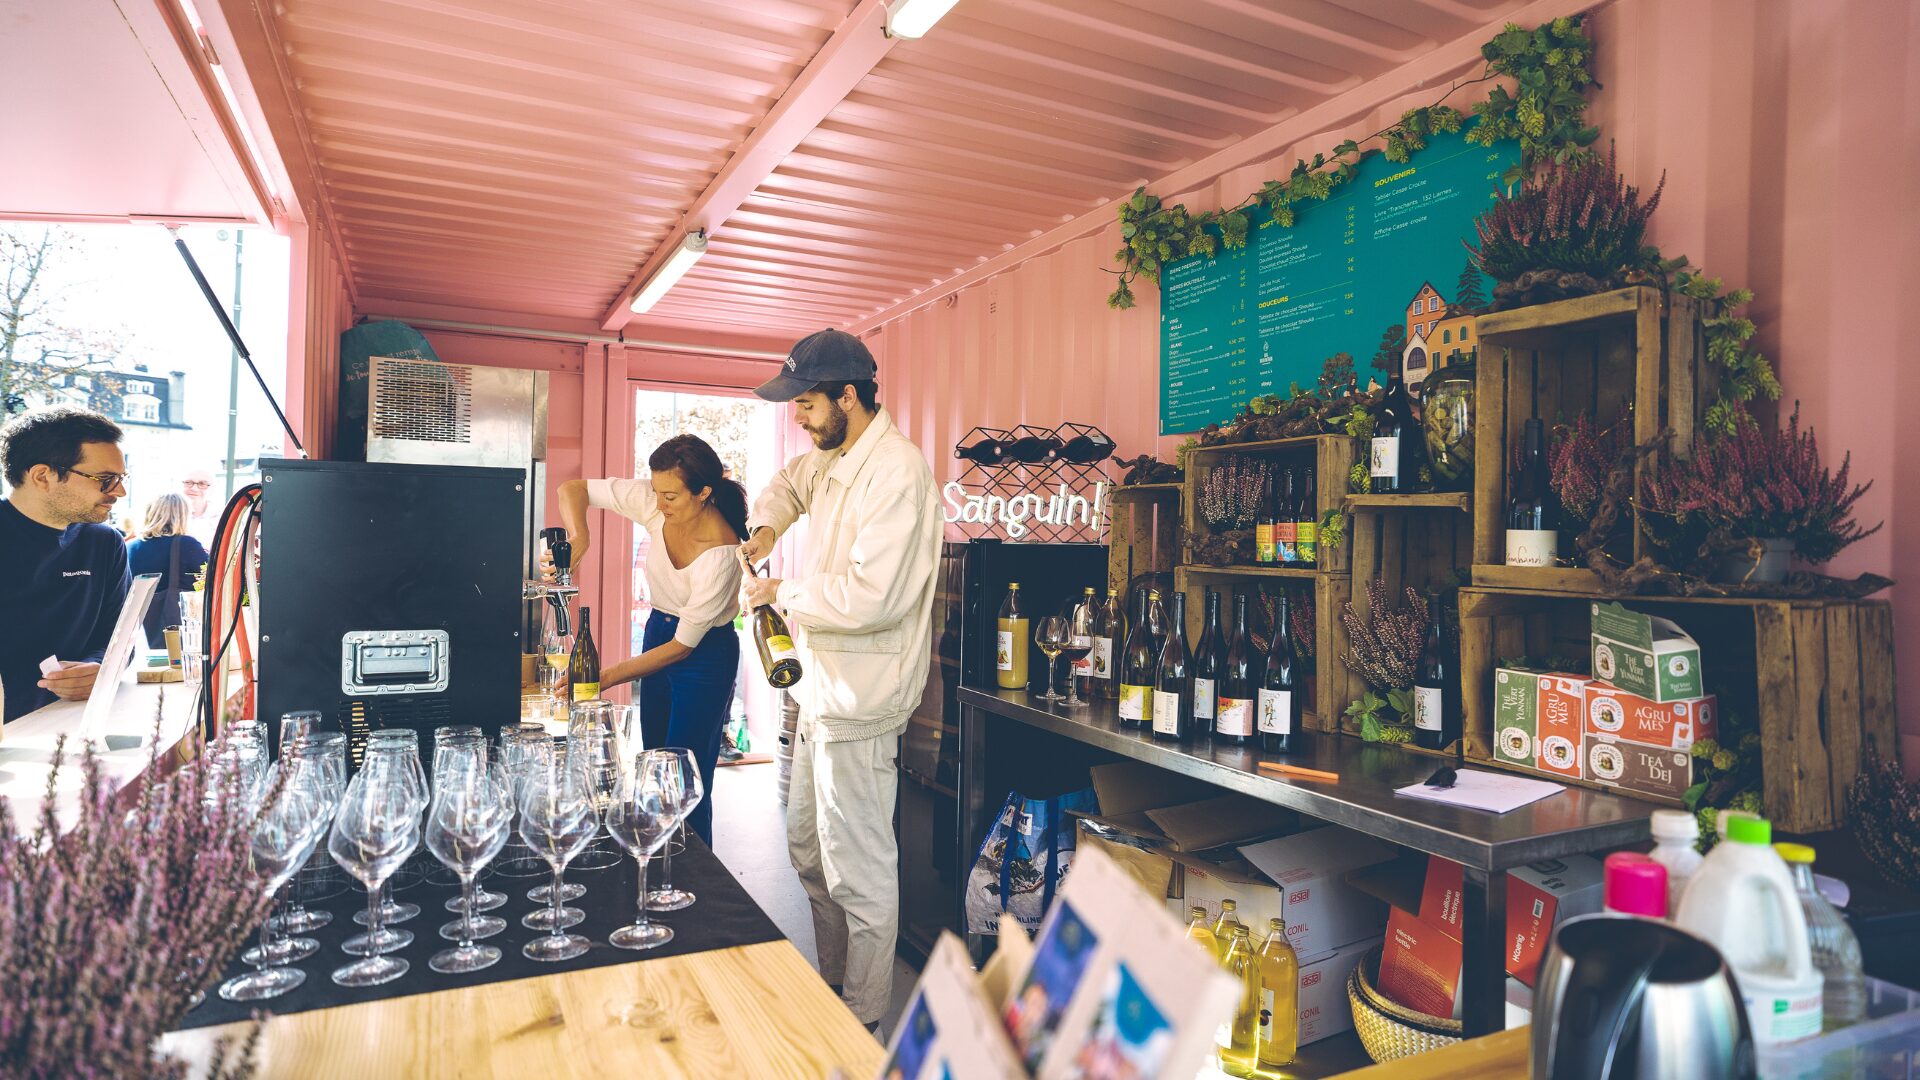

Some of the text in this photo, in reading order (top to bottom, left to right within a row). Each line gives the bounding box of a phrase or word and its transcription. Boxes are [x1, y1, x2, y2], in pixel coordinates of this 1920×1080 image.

[1374, 167, 1416, 188] SOUVENIRS
[1258, 295, 1289, 309] DOUCEURS
[942, 481, 1103, 538] Sanguin!
[1557, 701, 1569, 725] MES
[1639, 719, 1664, 731] MES
[1638, 753, 1664, 767] TEA
[1287, 923, 1309, 936] CONIL
[1396, 928, 1417, 946] electric
[1395, 934, 1411, 950] kettle
[1300, 1006, 1321, 1020] CONIL
